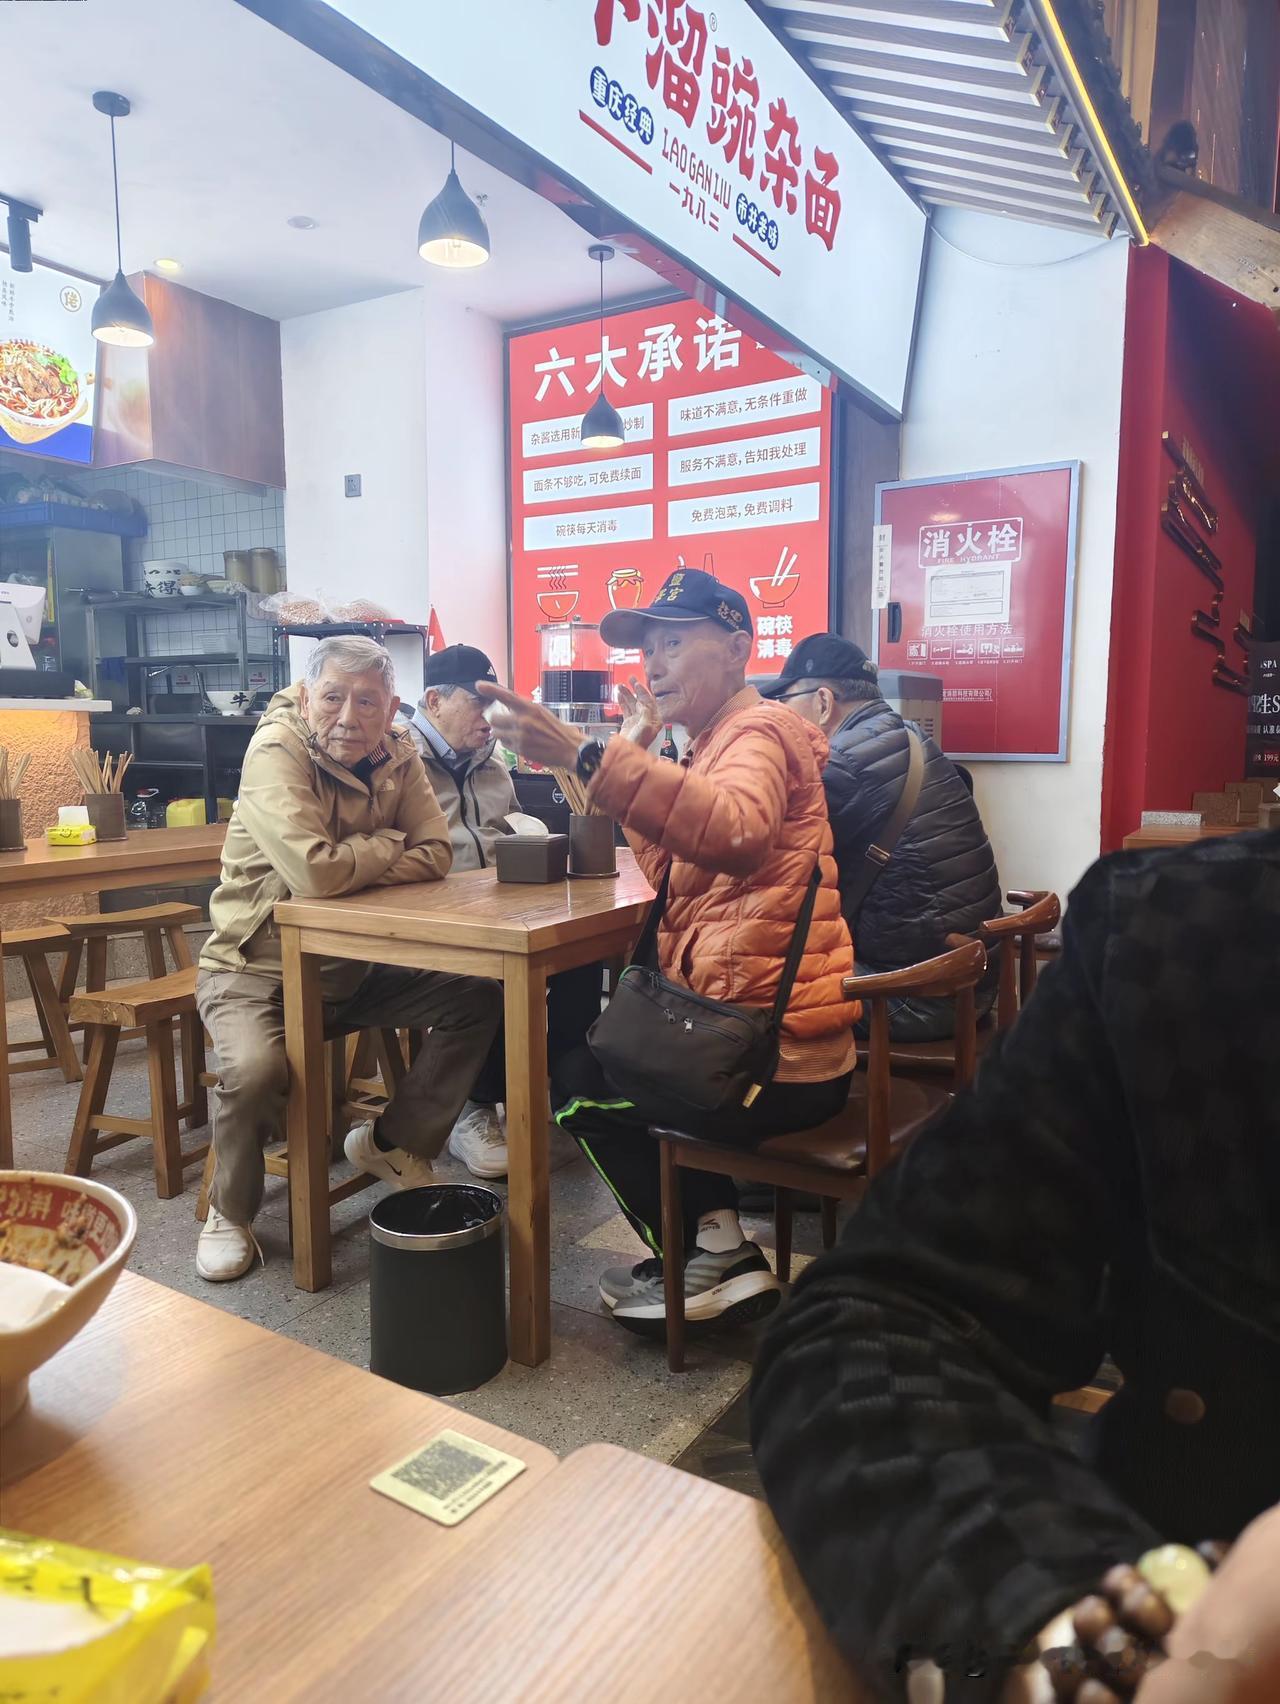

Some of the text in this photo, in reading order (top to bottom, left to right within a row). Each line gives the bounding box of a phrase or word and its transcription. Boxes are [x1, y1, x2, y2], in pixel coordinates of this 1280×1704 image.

[592, 68, 653, 142] 重庆经典
[662, 128, 731, 210] LAO GAN LIU
[669, 182, 719, 232] 一九八二
[737, 194, 777, 249] 市井老味
[534, 314, 742, 402] 六大承诺
[556, 520, 617, 537] 碗筷每天消毒
[923, 524, 1018, 558] 消火栓
[960, 553, 1000, 563] HYDRANT
[757, 614, 793, 636] 碗筷
[921, 622, 1013, 638] 消火栓使用方法
[230, 692, 249, 708] 牛
